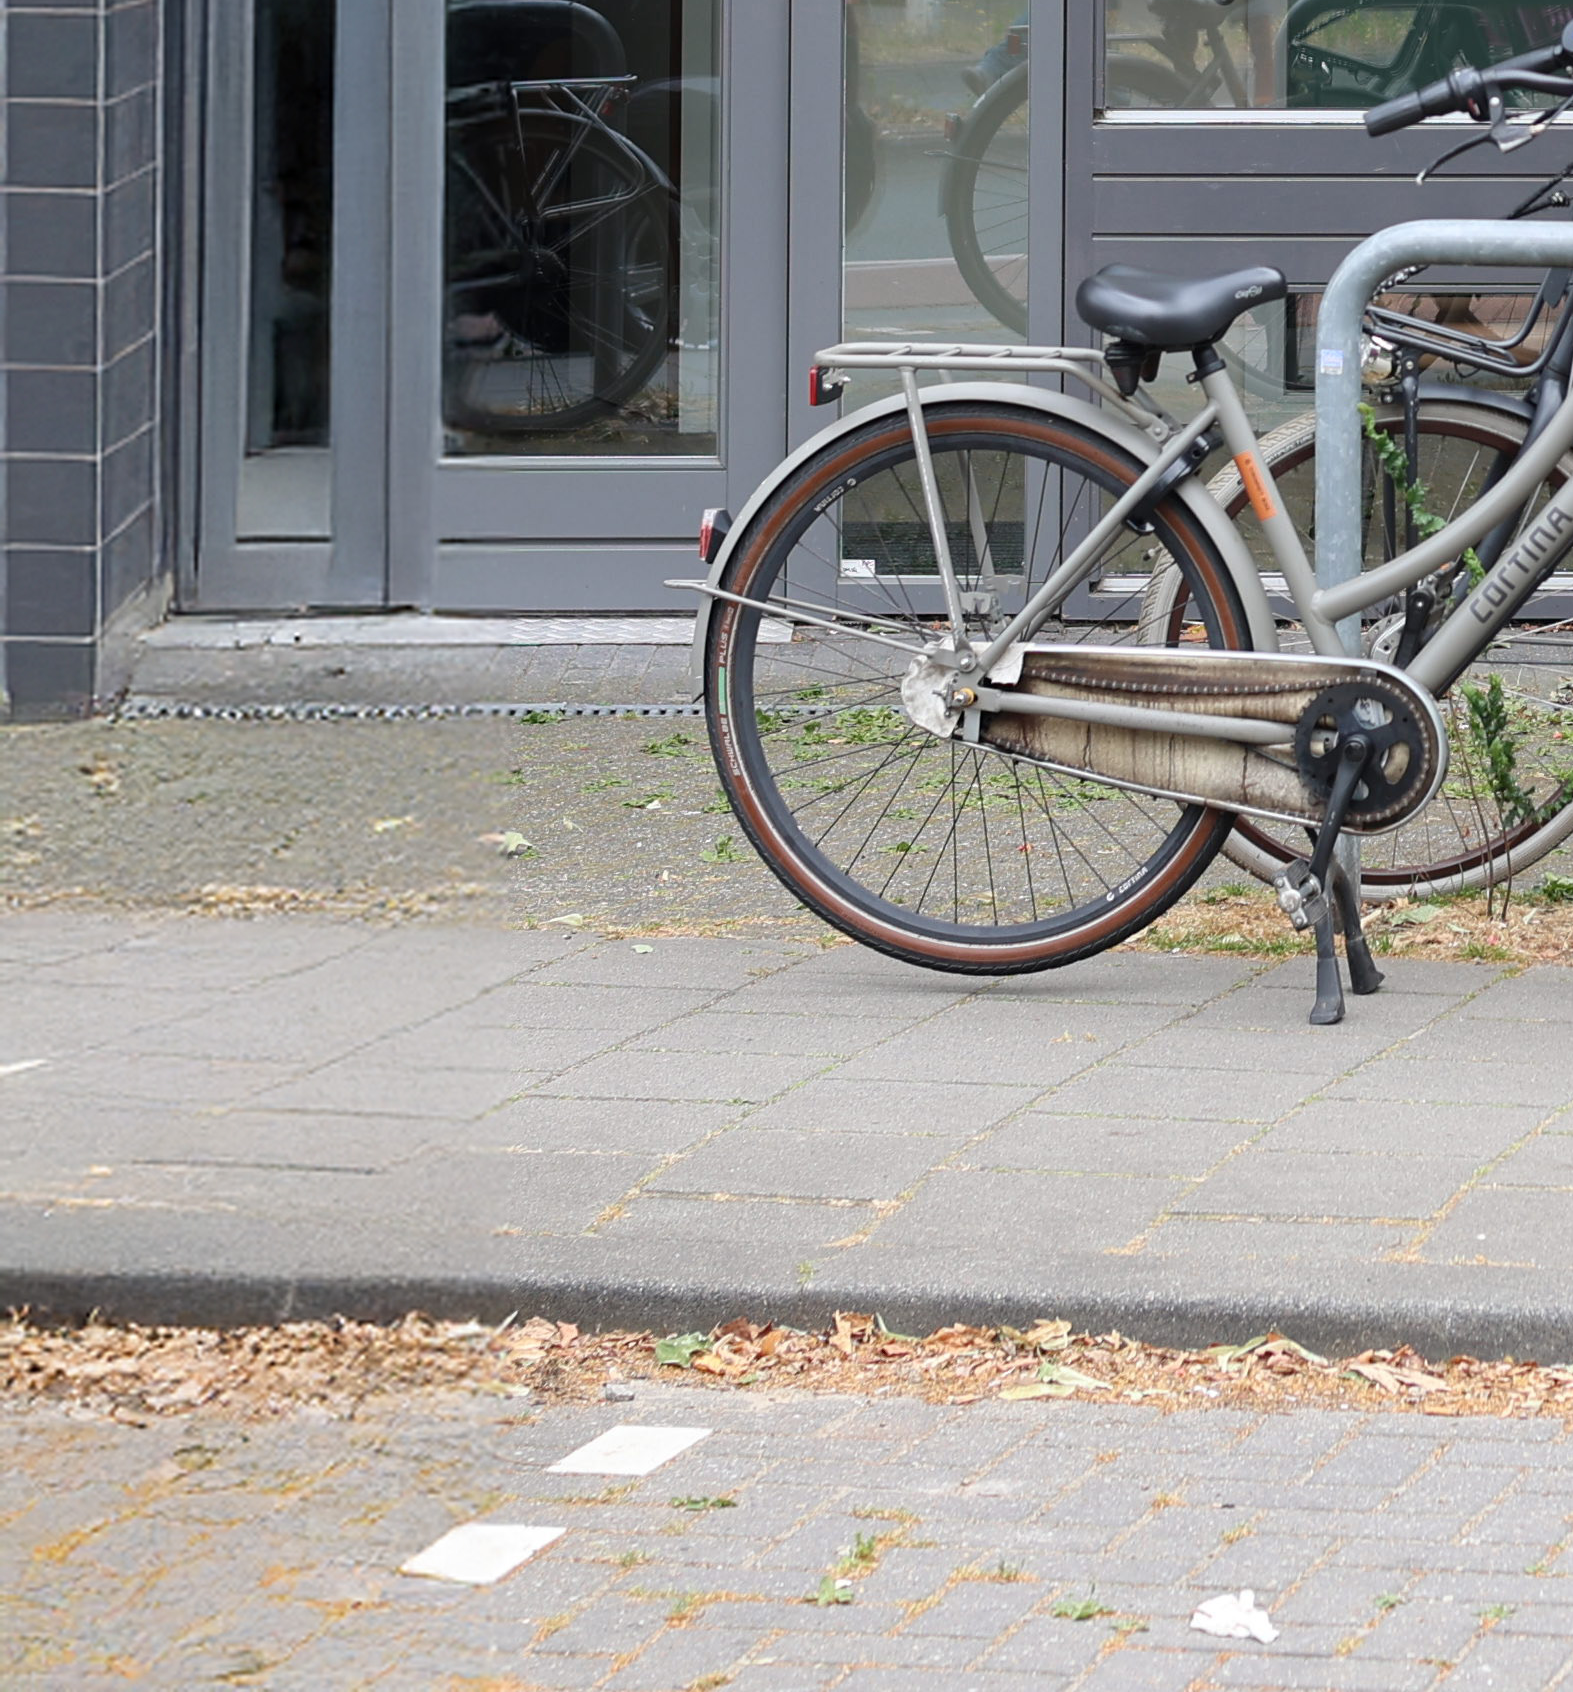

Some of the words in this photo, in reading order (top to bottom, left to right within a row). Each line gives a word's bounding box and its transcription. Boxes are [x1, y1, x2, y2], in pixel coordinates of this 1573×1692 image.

[718, 633, 729, 664] PLUS
[720, 717, 741, 777] SCHWALBE
[1118, 865, 1149, 894] CORTINA
